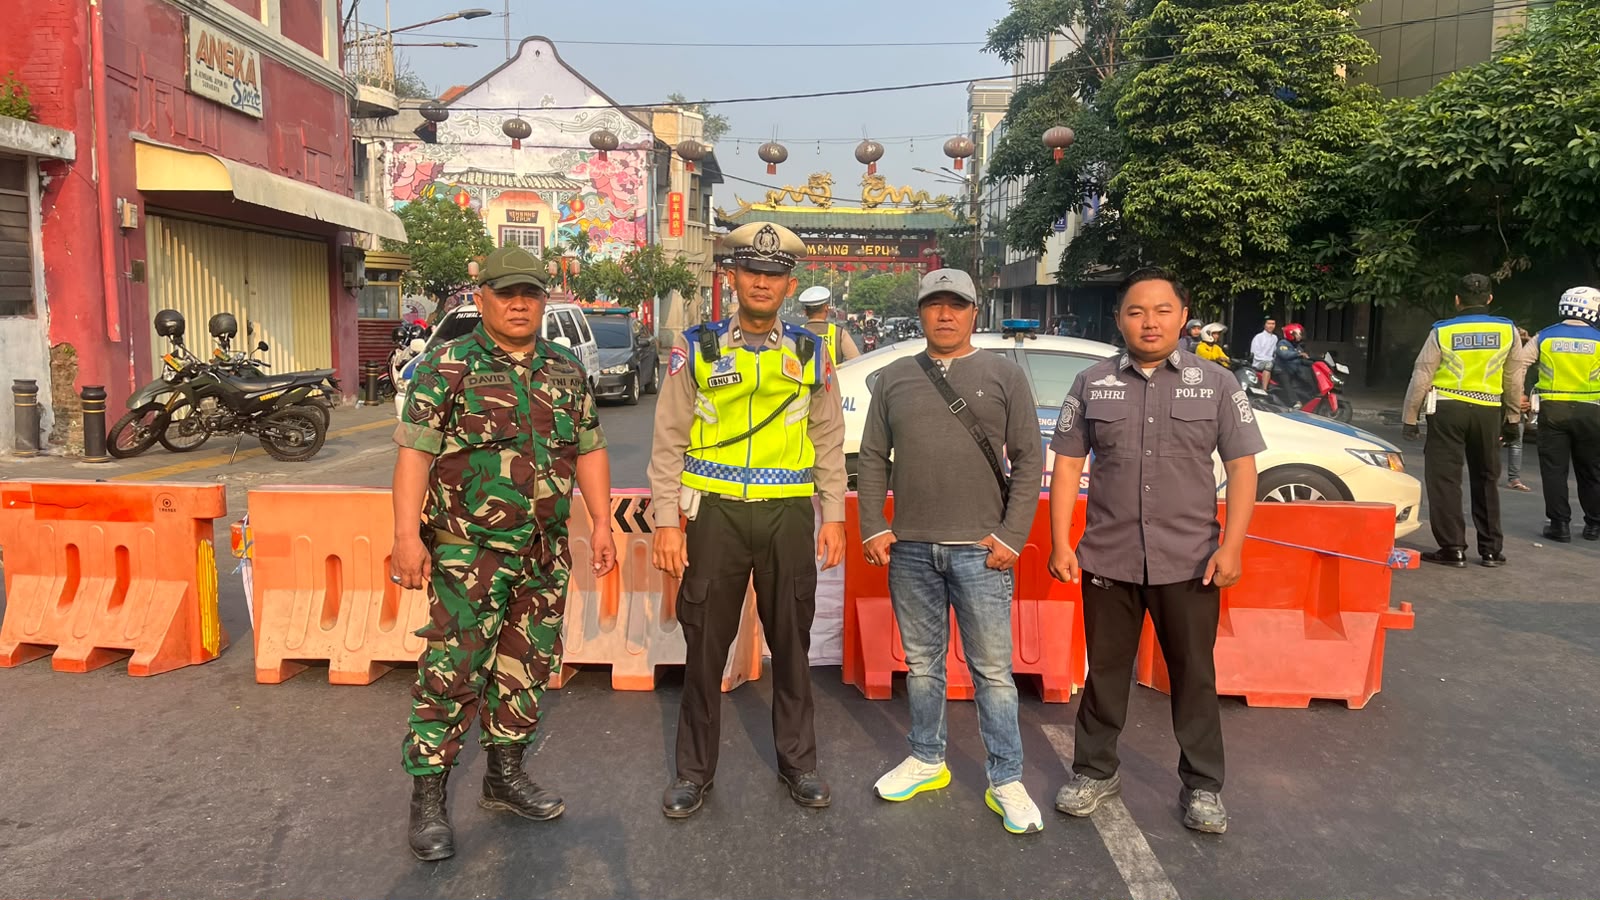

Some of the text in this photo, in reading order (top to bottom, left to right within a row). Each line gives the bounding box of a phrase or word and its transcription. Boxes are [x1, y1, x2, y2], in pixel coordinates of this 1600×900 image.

[196, 30, 258, 92] ANEKA
[231, 78, 261, 111] Sport
[1453, 335, 1499, 347] POLISI
[1553, 341, 1595, 353] POLISI
[468, 375, 505, 386] DAVID
[550, 378, 566, 386] TNI
[711, 374, 738, 386] IBNU N
[1090, 390, 1126, 400] FAHRI
[1175, 388, 1214, 398] POL PP
[841, 397, 856, 411] AL
